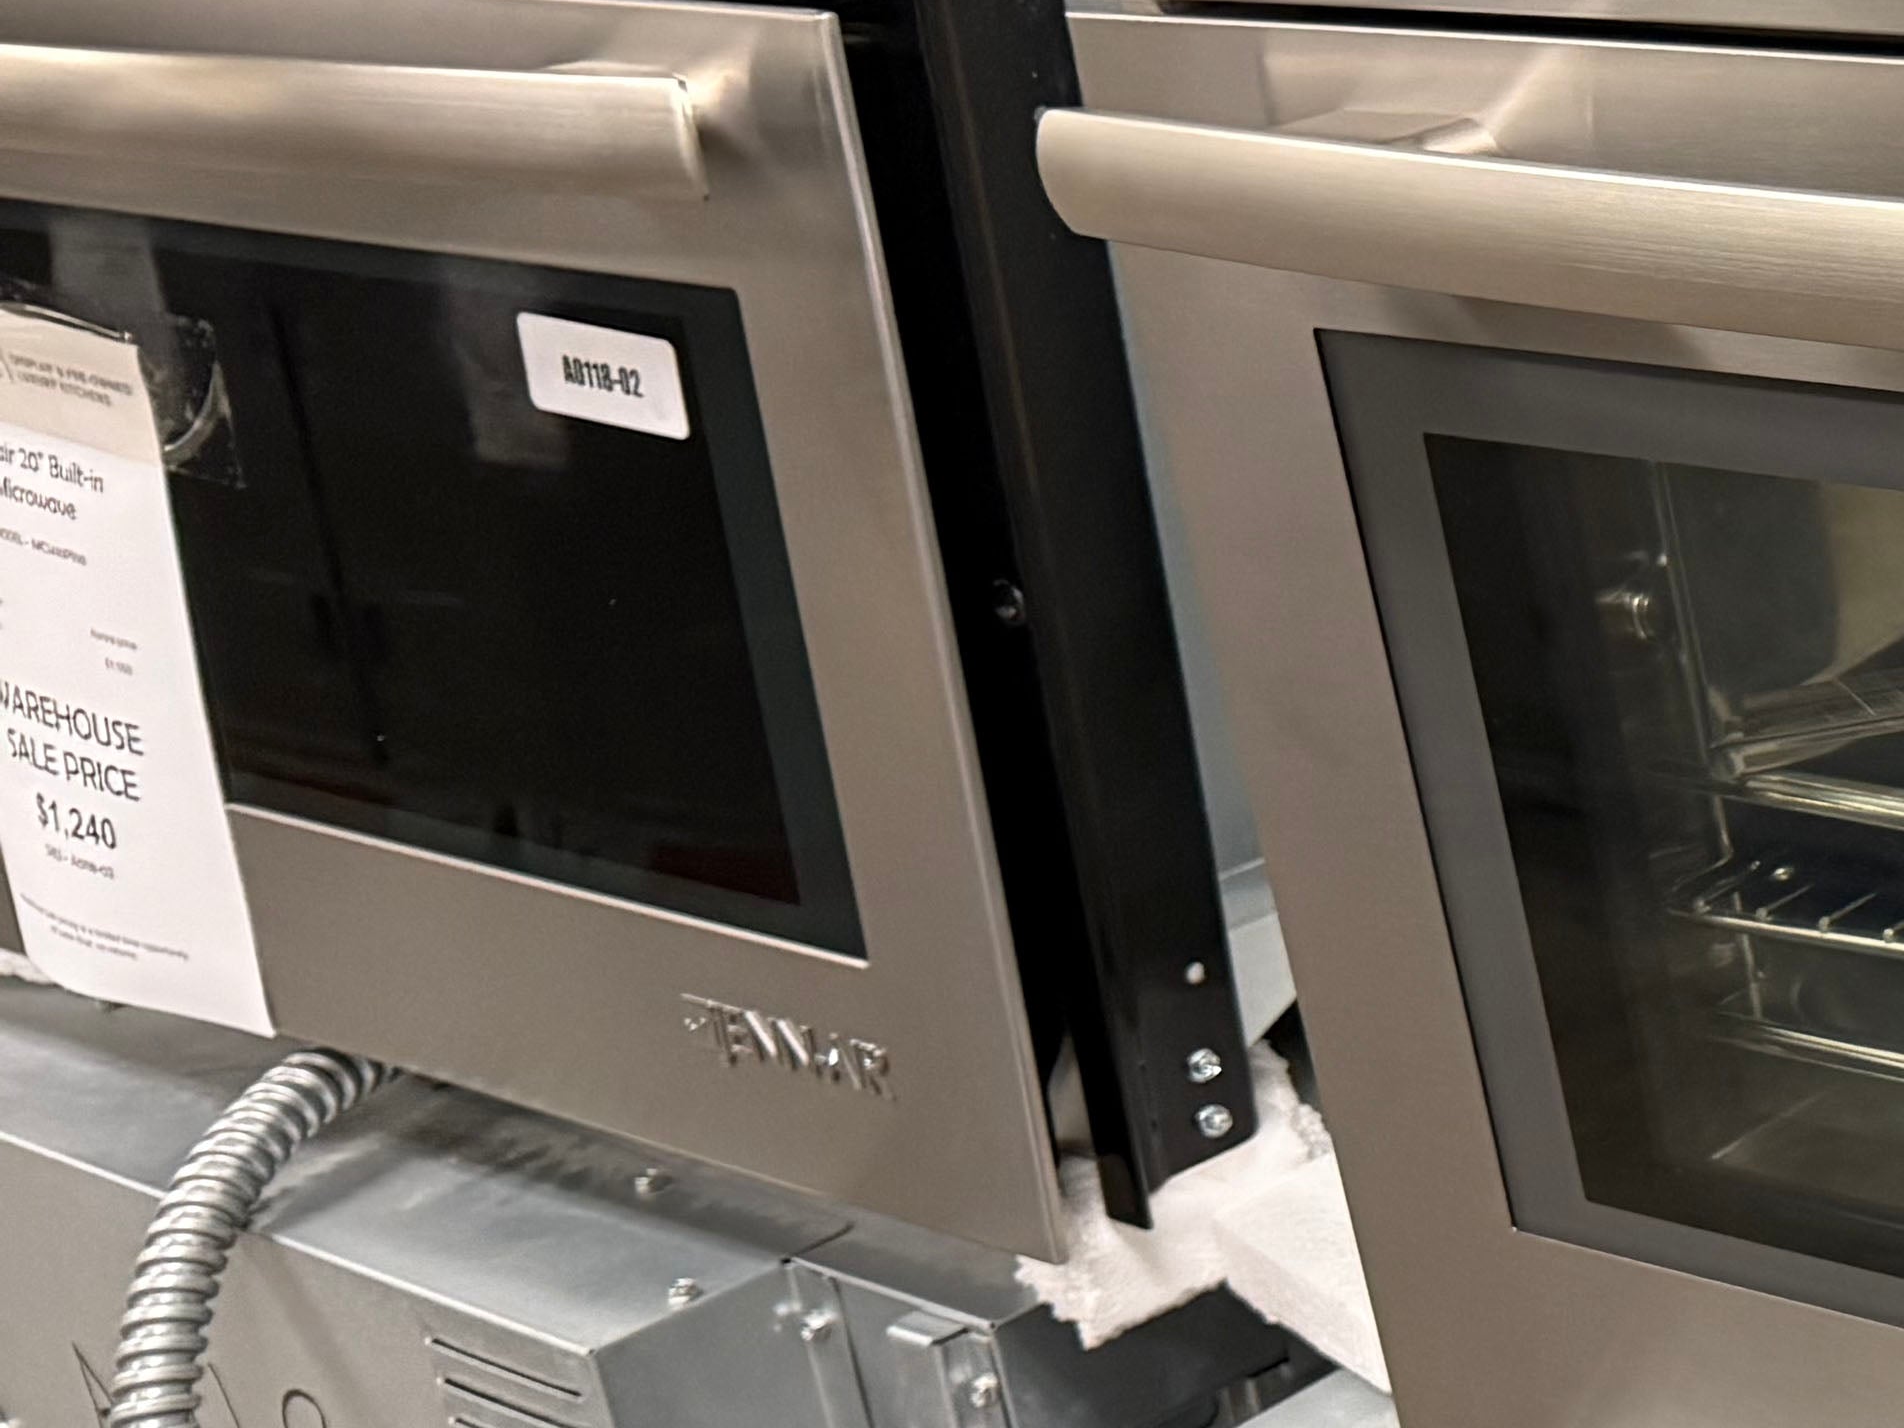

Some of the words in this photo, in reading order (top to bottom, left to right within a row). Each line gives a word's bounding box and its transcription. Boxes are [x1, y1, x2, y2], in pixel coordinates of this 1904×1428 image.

[561, 354, 645, 398] A0118-02
[48, 454, 104, 493] Built-in
[7, 727, 60, 776] SALE
[62, 750, 141, 802] PRICE
[36, 791, 117, 850] $1,240
